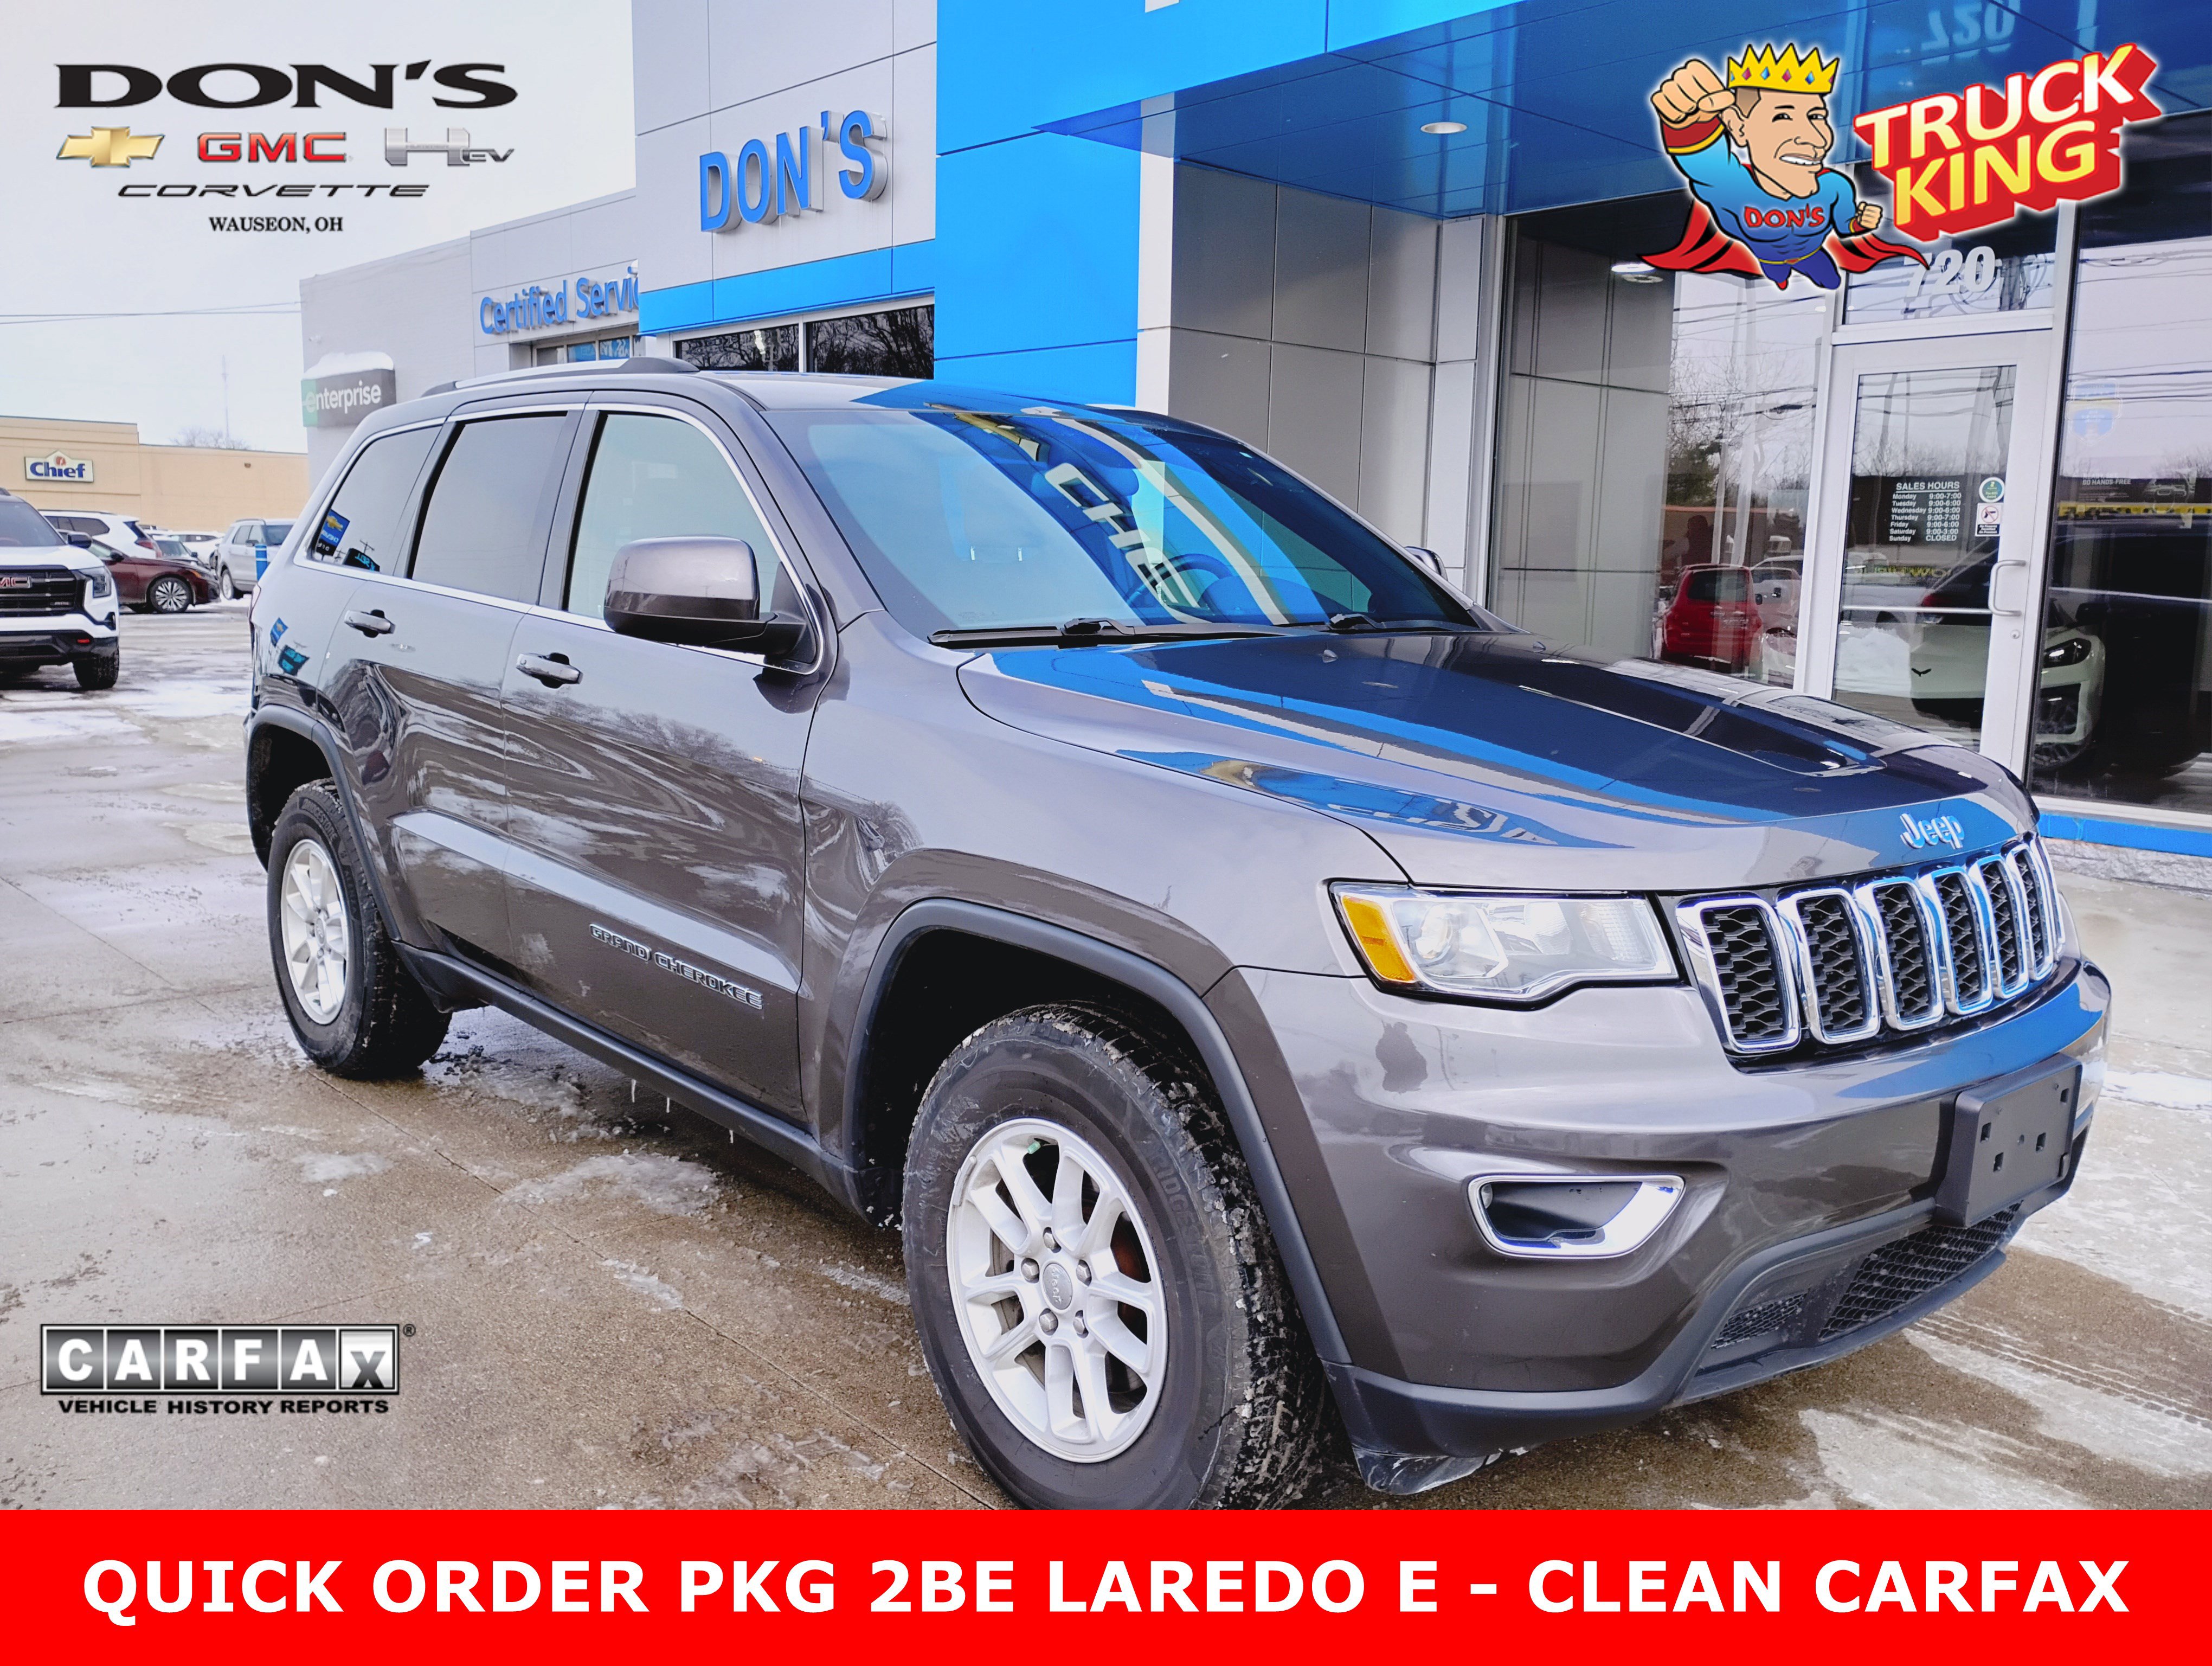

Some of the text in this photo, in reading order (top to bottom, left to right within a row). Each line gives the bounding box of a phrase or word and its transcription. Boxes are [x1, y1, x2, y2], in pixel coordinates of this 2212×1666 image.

[699, 110, 875, 232] DON'S
[1904, 246, 1996, 296] 720
[480, 279, 568, 335] Certified
[302, 380, 382, 414] enterprise
[29, 462, 86, 478] Chief
[1896, 481, 1960, 490] SALES HOURS
[1900, 813, 1965, 850] Jeep
[589, 923, 763, 1010] GRAND CHEROKEE
[1051, 1267, 1062, 1304] Jeep
